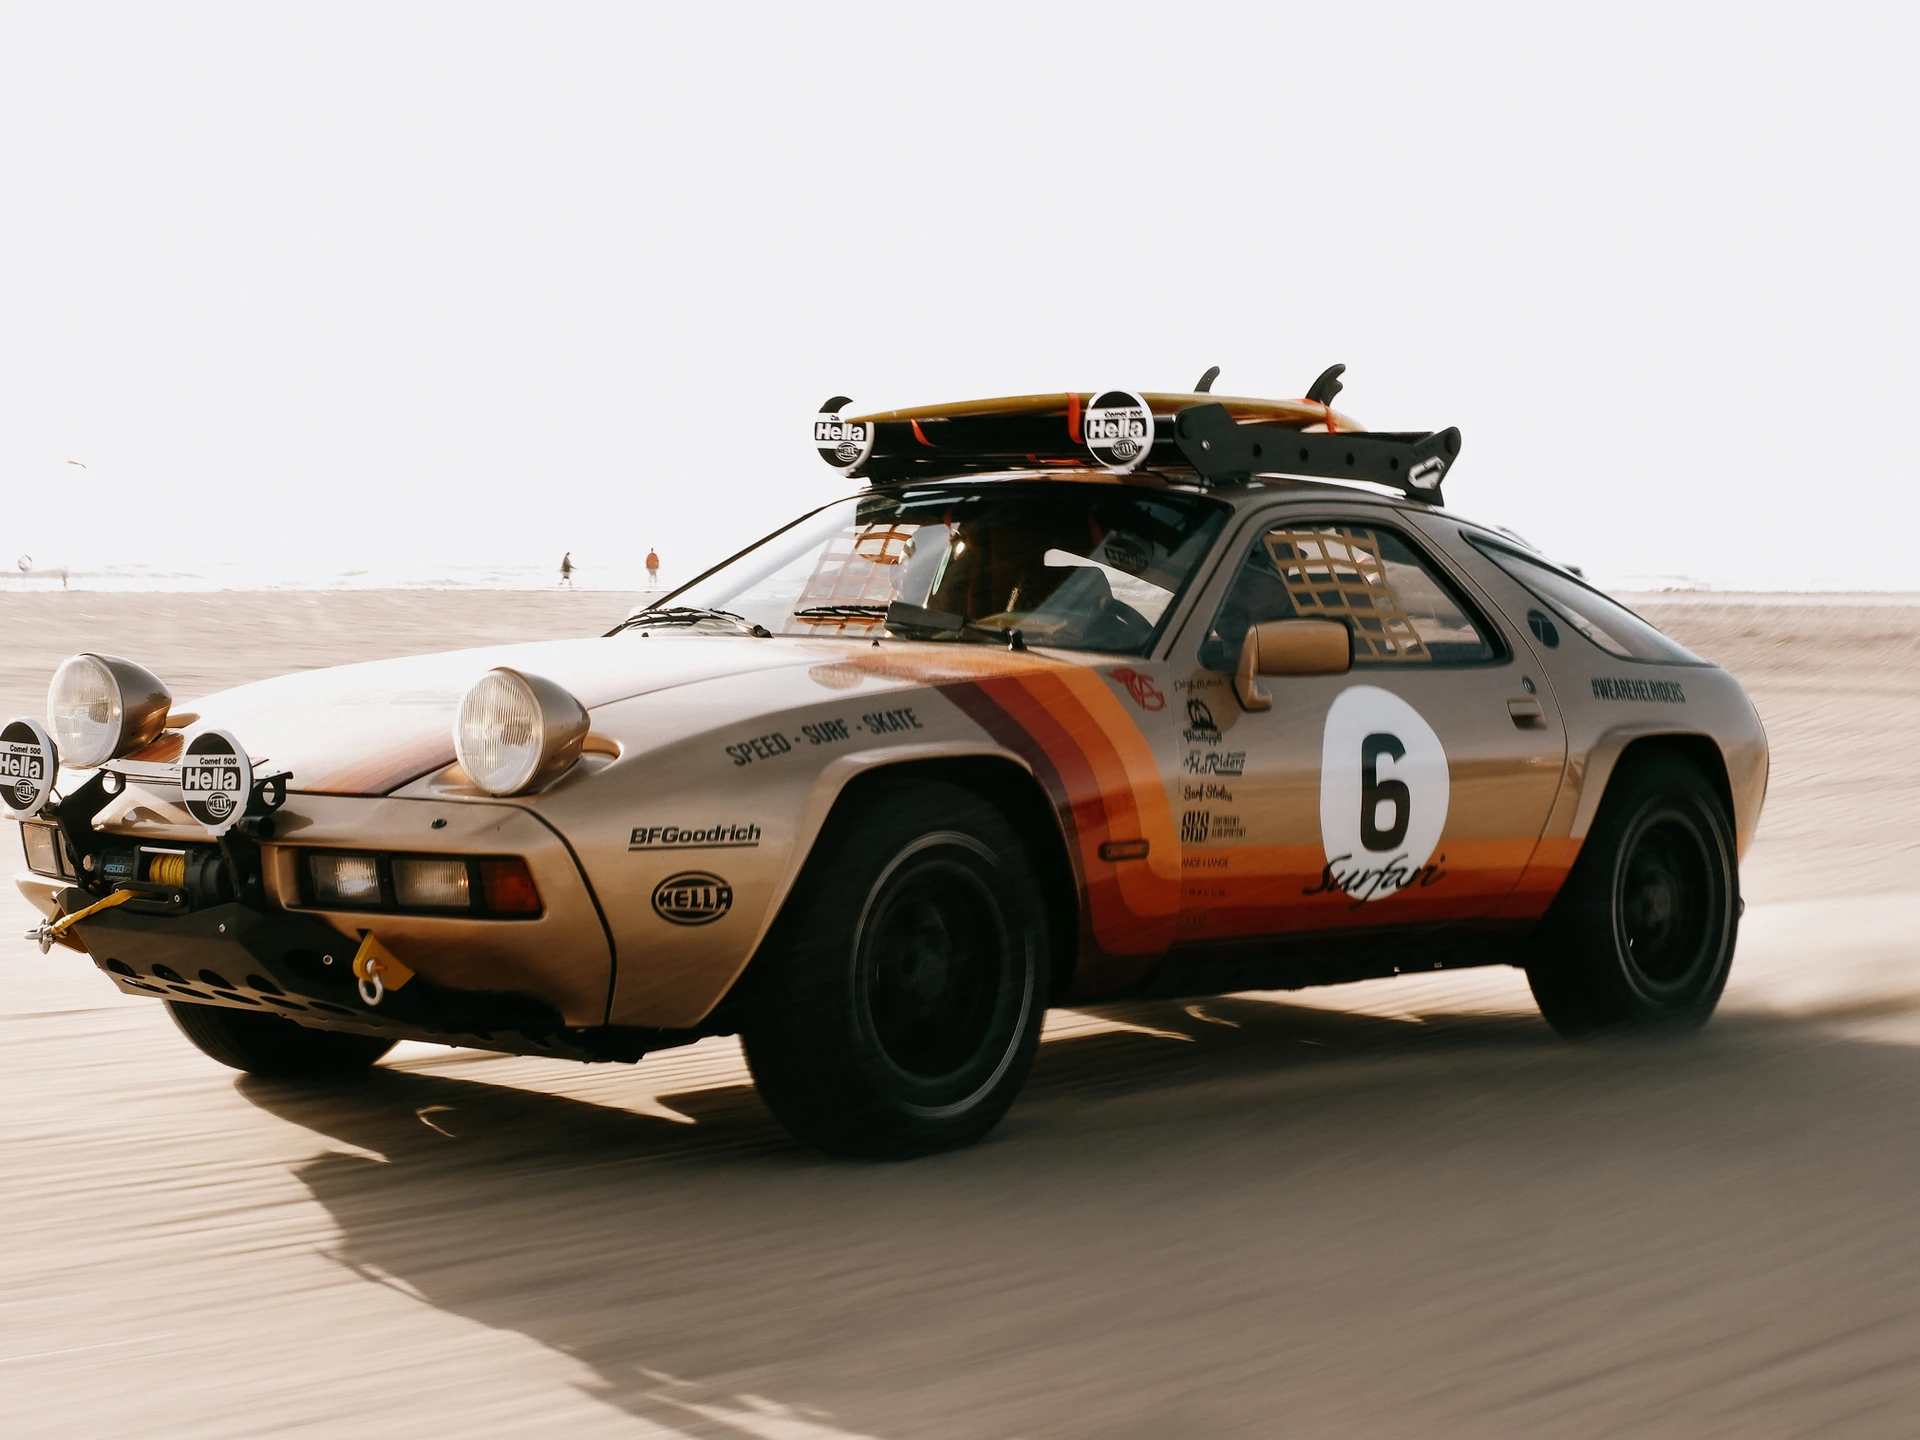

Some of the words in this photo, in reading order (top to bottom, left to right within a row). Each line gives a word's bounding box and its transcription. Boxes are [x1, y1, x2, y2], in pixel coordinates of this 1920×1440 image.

[816, 423, 865, 440] Hella
[1089, 419, 1144, 439] Hella
[1590, 678, 1686, 704] #WEAREHELRIDERS
[725, 732, 792, 767] SPEED
[801, 718, 850, 746] SURF
[862, 707, 924, 735] SKATE
[9, 744, 28, 754] Comet
[29, 746, 42, 755] 500
[0, 753, 41, 779] Hella
[199, 757, 221, 766] Comet
[223, 757, 237, 765] 500
[184, 767, 238, 790] Hella
[16, 784, 35, 797] HELLA
[1360, 733, 1411, 853] 6
[208, 797, 232, 810] HELLA
[629, 823, 762, 845] BFGoodrich
[1302, 853, 1447, 911] Surfari
[657, 885, 733, 911] HELLA
